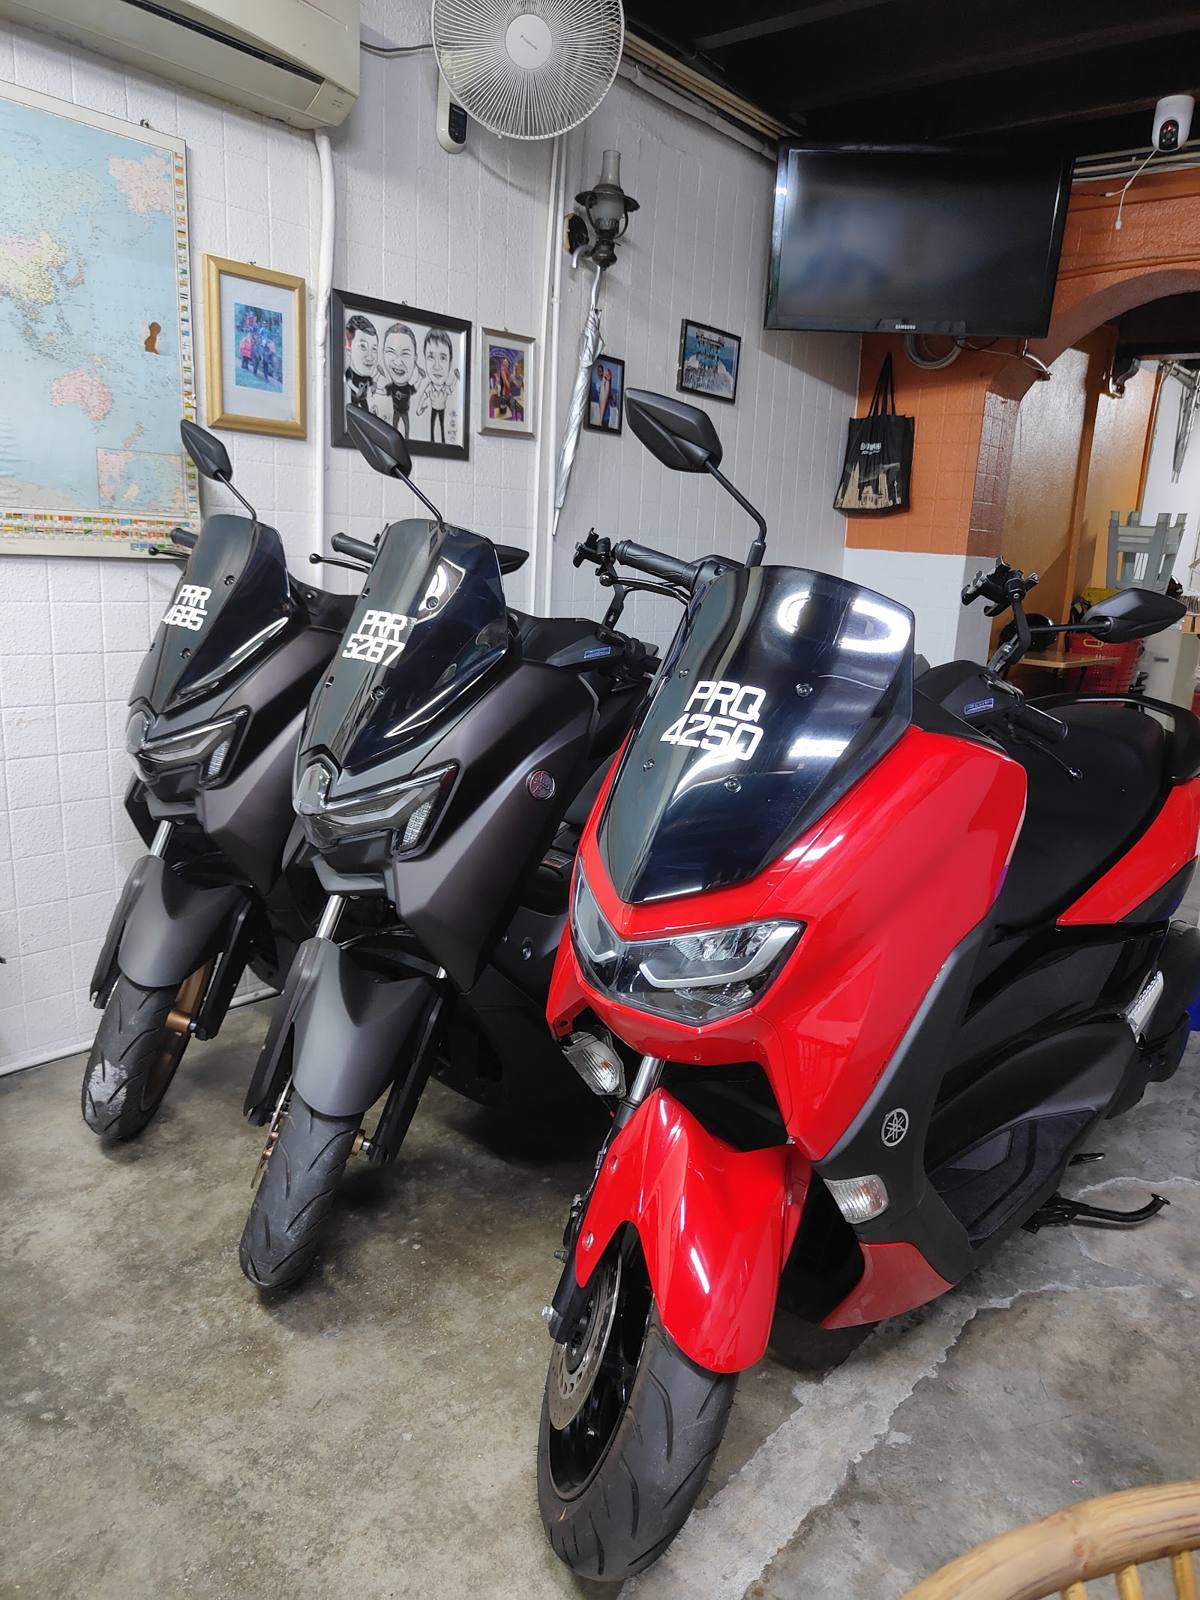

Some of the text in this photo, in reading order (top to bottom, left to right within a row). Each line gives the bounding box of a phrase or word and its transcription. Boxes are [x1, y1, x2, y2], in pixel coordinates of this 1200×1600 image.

[174, 584, 212, 610] PRR
[160, 604, 208, 632] 4685
[356, 609, 408, 642] PRR
[342, 633, 406, 666] 5287
[683, 680, 767, 723] PRQ
[659, 713, 764, 761] 4250
